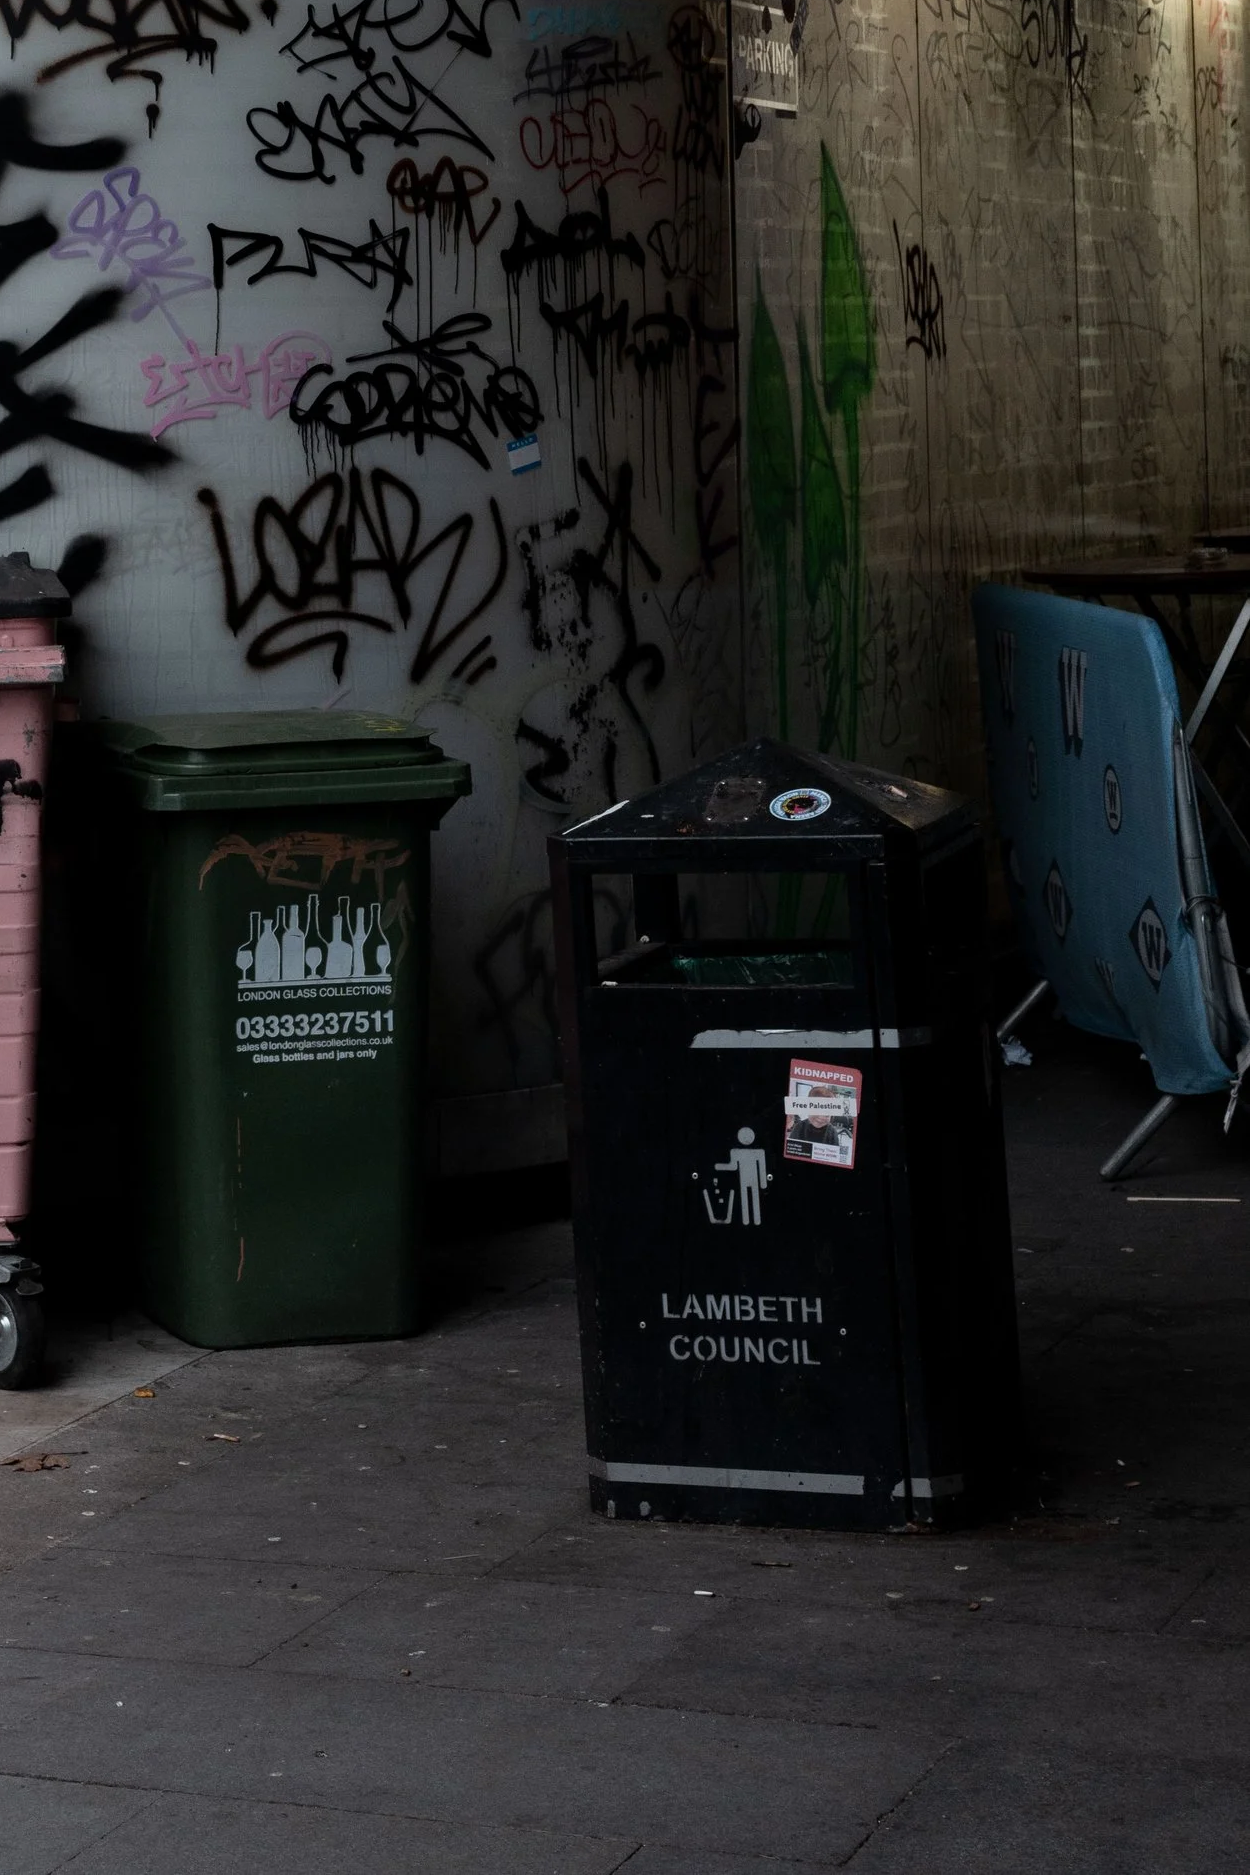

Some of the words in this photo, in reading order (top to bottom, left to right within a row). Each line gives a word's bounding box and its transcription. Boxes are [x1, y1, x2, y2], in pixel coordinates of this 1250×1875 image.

[738, 34, 796, 78] PARKING
[237, 991, 281, 1002] LONDON
[283, 988, 317, 1000] GLASS
[319, 985, 392, 997] COLLECTIONS
[235, 1009, 394, 1040] 03333237511
[236, 1036, 393, 1052] sales@londonglasscollections.co.uk
[253, 1054, 280, 1064] Glass
[282, 1052, 314, 1062] bottles
[316, 1050, 335, 1060] and
[336, 1050, 354, 1061] jars
[356, 1049, 377, 1060] only
[794, 1066, 854, 1083] KIDNAPPED
[792, 1101, 807, 1109] Free
[809, 1101, 842, 1110] Palestine
[661, 1293, 823, 1324] LAMBETH
[669, 1334, 821, 1365] COUNCIL
